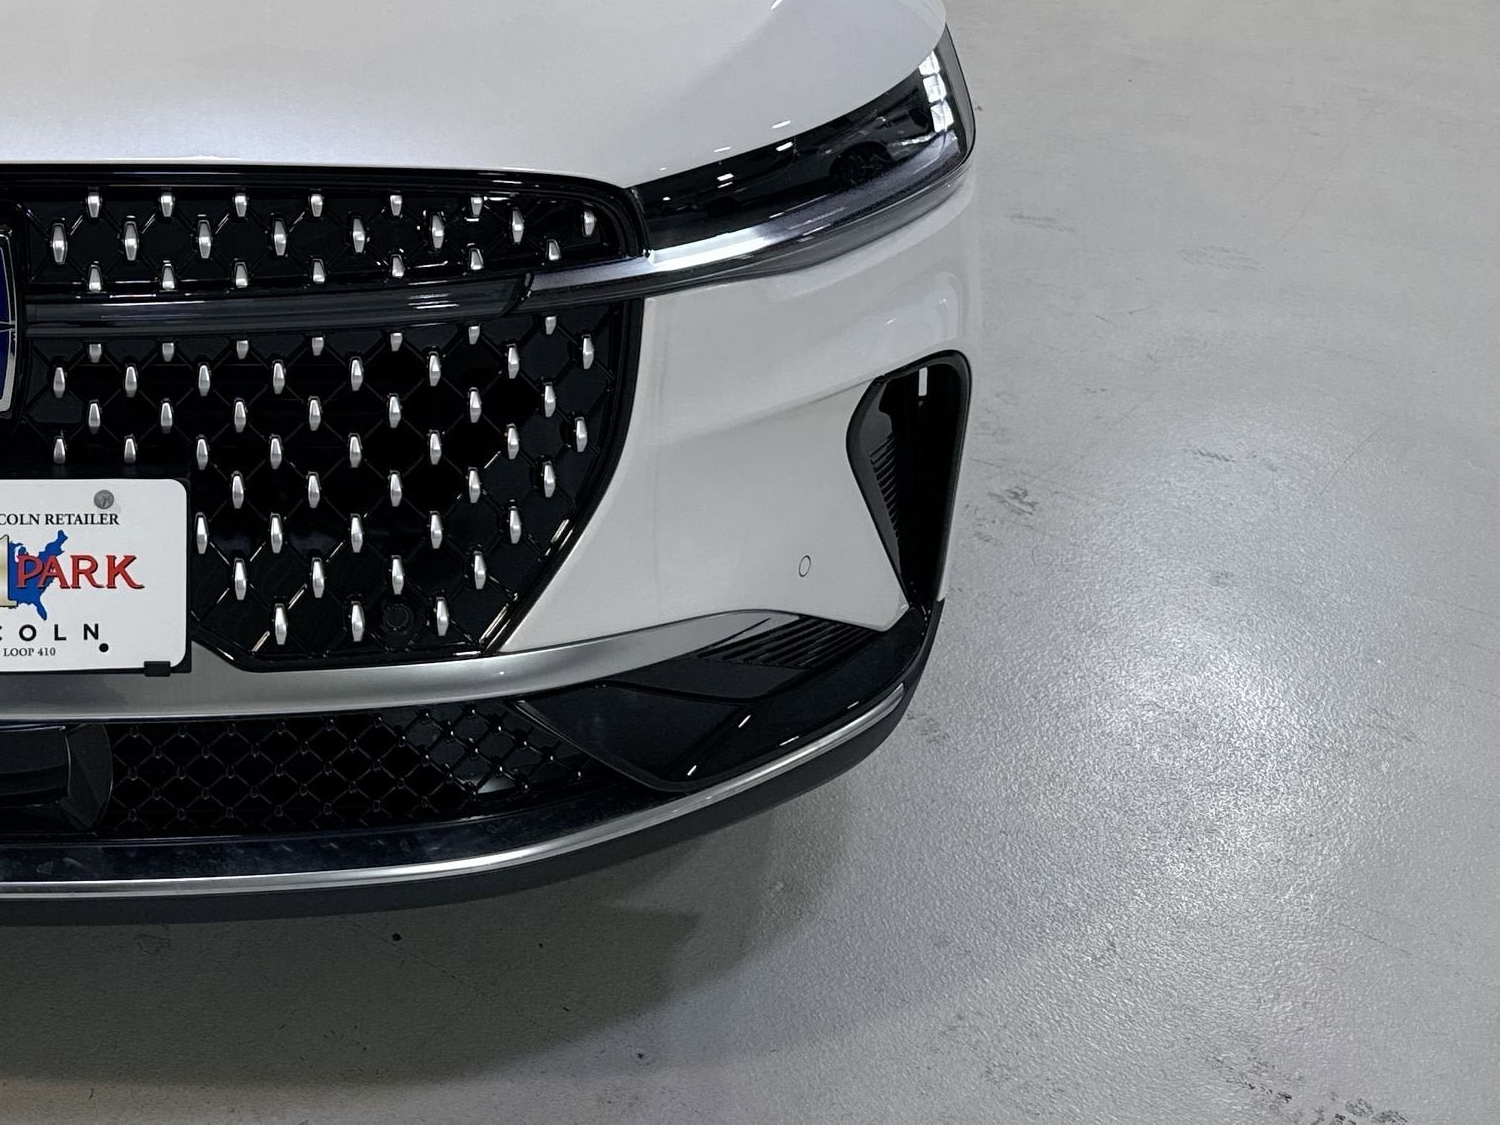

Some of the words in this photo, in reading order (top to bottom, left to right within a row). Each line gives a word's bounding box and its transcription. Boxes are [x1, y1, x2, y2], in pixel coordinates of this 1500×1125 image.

[44, 513, 120, 526] RETAILER
[15, 554, 146, 589] PARK
[3, 647, 34, 657] LOOP
[37, 647, 56, 657] 410
